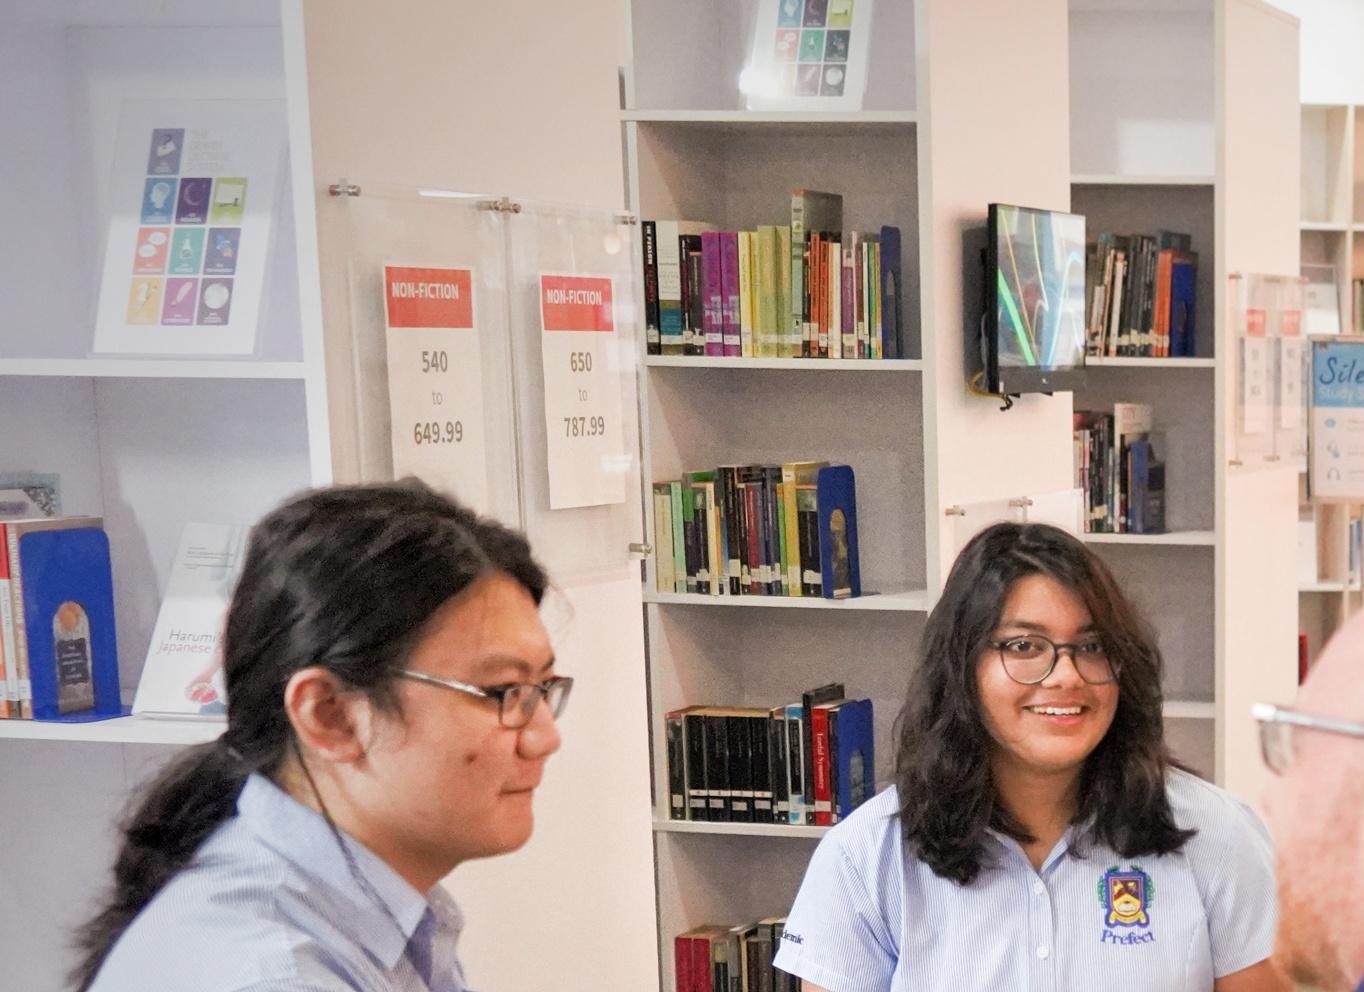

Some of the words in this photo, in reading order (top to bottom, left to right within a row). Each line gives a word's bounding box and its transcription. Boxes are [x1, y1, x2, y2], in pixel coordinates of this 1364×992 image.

[391, 281, 460, 300] NON-FICTION
[546, 288, 603, 306] NON-FICTION
[421, 350, 448, 373] 540
[569, 351, 593, 373] 650
[431, 389, 444, 406] to
[577, 388, 588, 403] to
[413, 420, 464, 445] 649.99
[563, 415, 606, 438] 787.99
[1100, 929, 1157, 945] Prefect
